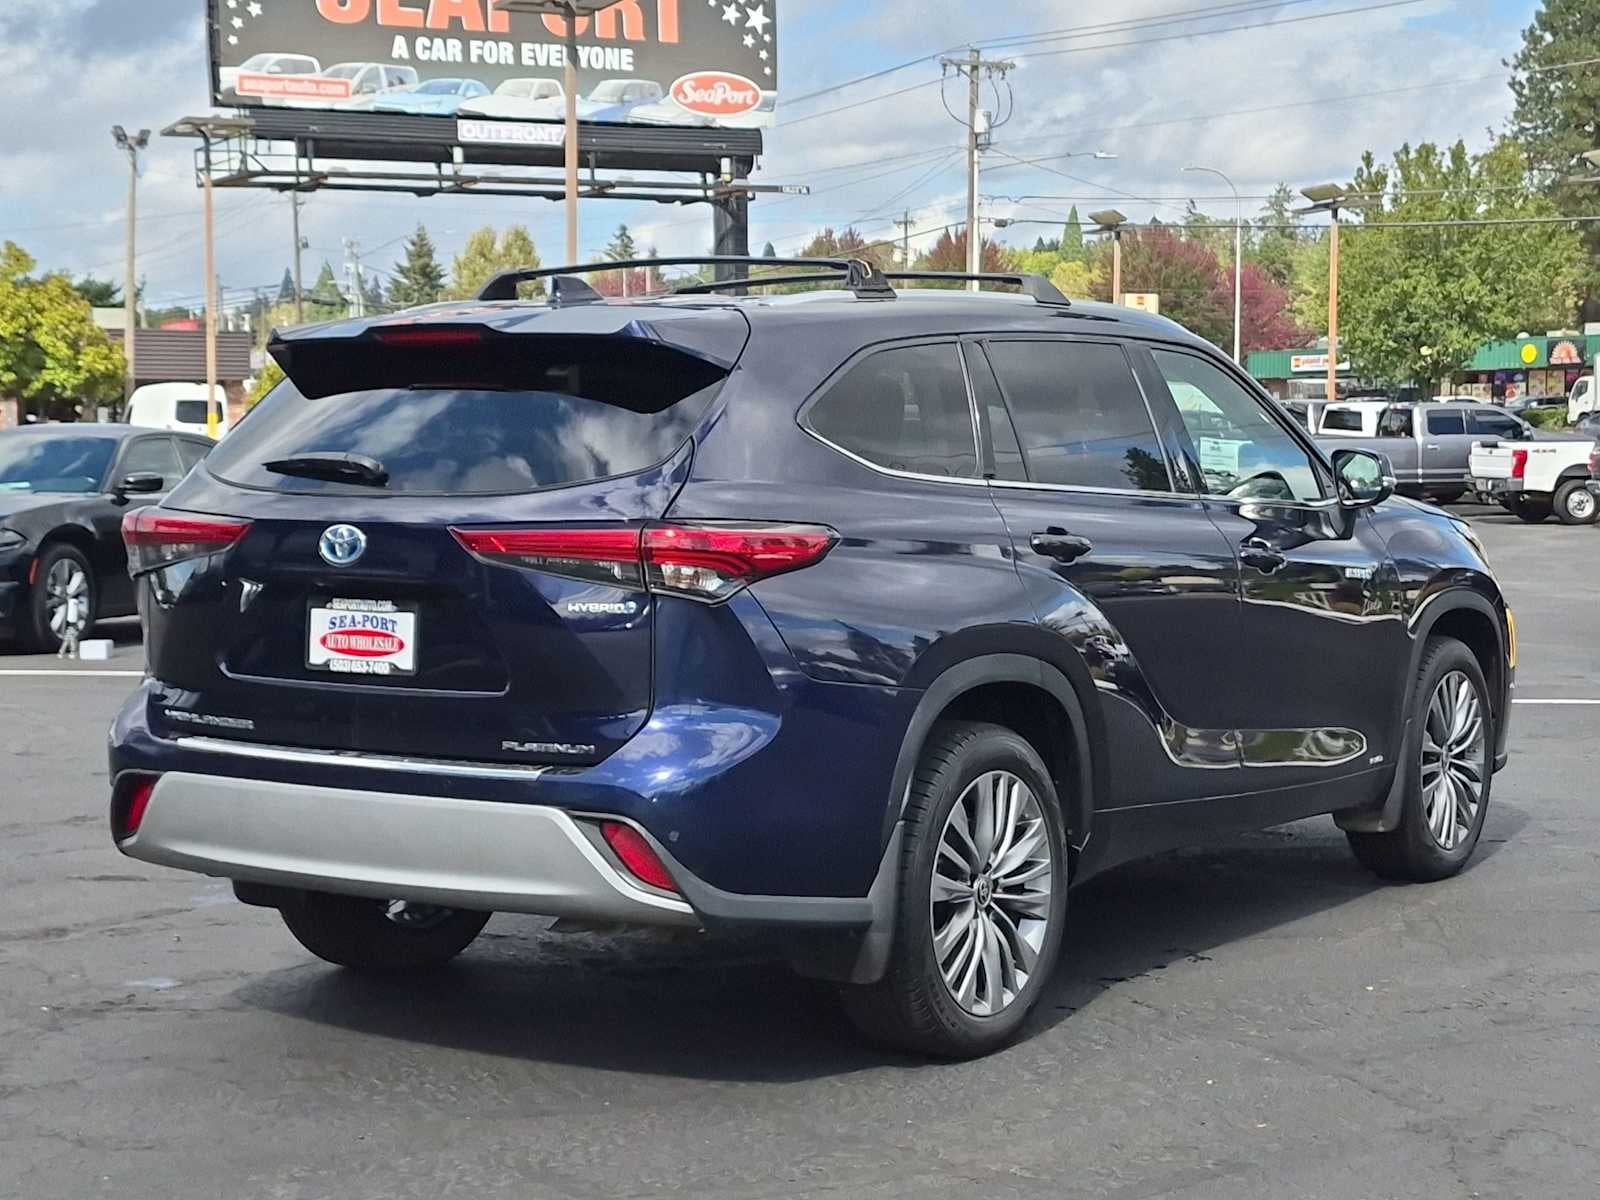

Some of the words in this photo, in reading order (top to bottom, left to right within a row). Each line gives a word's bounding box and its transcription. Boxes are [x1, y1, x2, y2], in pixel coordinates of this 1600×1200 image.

[391, 35, 410, 60] A
[414, 36, 463, 63] CAR
[469, 40, 515, 65] FOR
[521, 42, 635, 71] EVEYONE
[678, 80, 755, 106] SeaPort
[328, 614, 398, 633] SEA-PORT
[325, 634, 350, 651] AUTO
[350, 635, 400, 654] WHOLESALE
